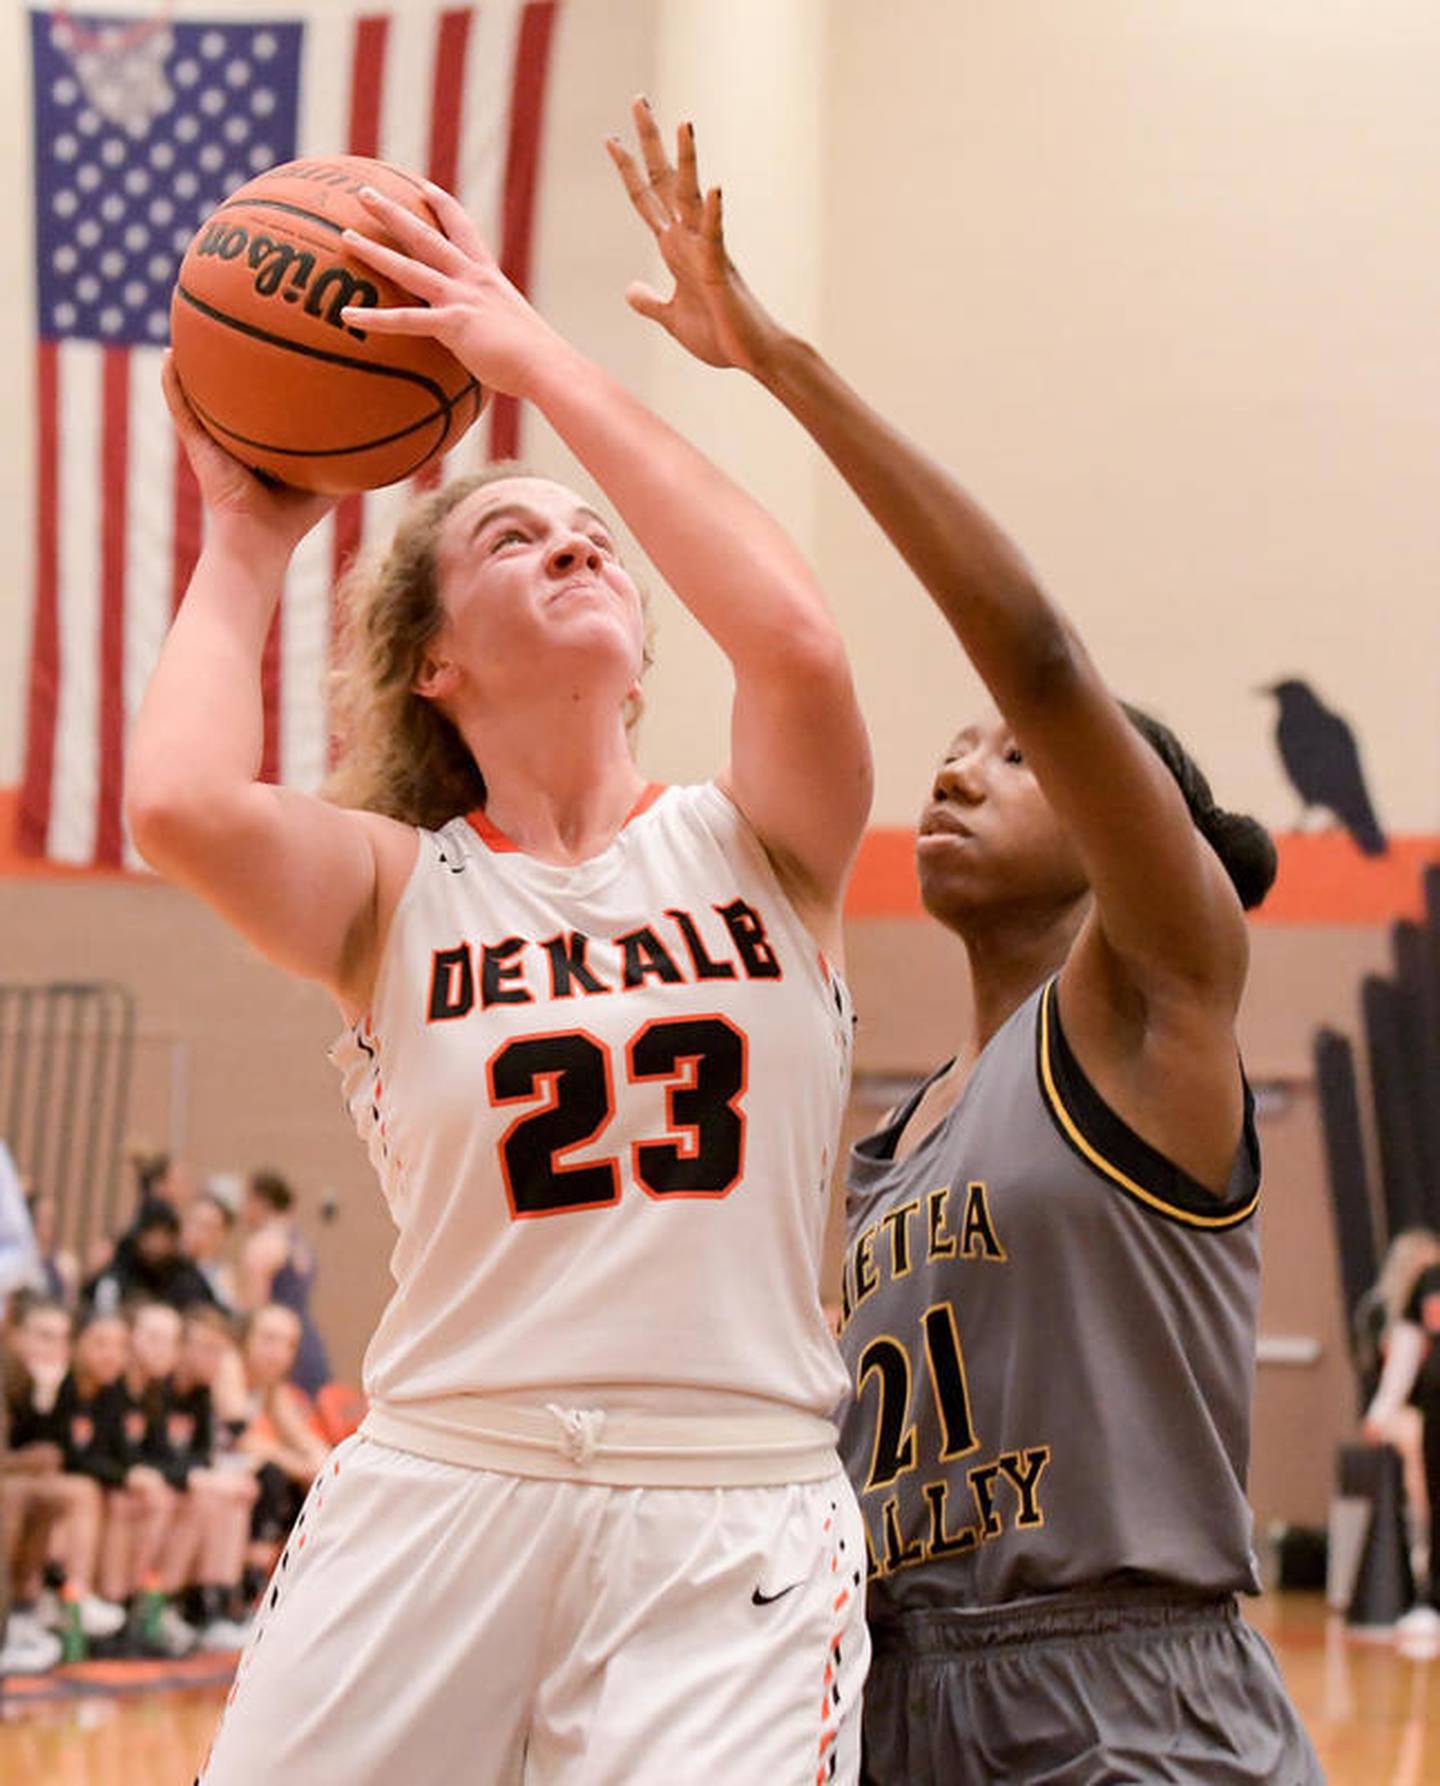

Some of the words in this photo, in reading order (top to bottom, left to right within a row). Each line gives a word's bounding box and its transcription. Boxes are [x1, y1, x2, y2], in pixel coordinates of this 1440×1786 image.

[196, 222, 380, 342] Wilson
[426, 896, 783, 1024] DEKALB
[485, 1012, 749, 1221] 23
[836, 1181, 1007, 1340] ETEA
[857, 1302, 980, 1492] 21
[866, 1446, 1051, 1581] LLEY
